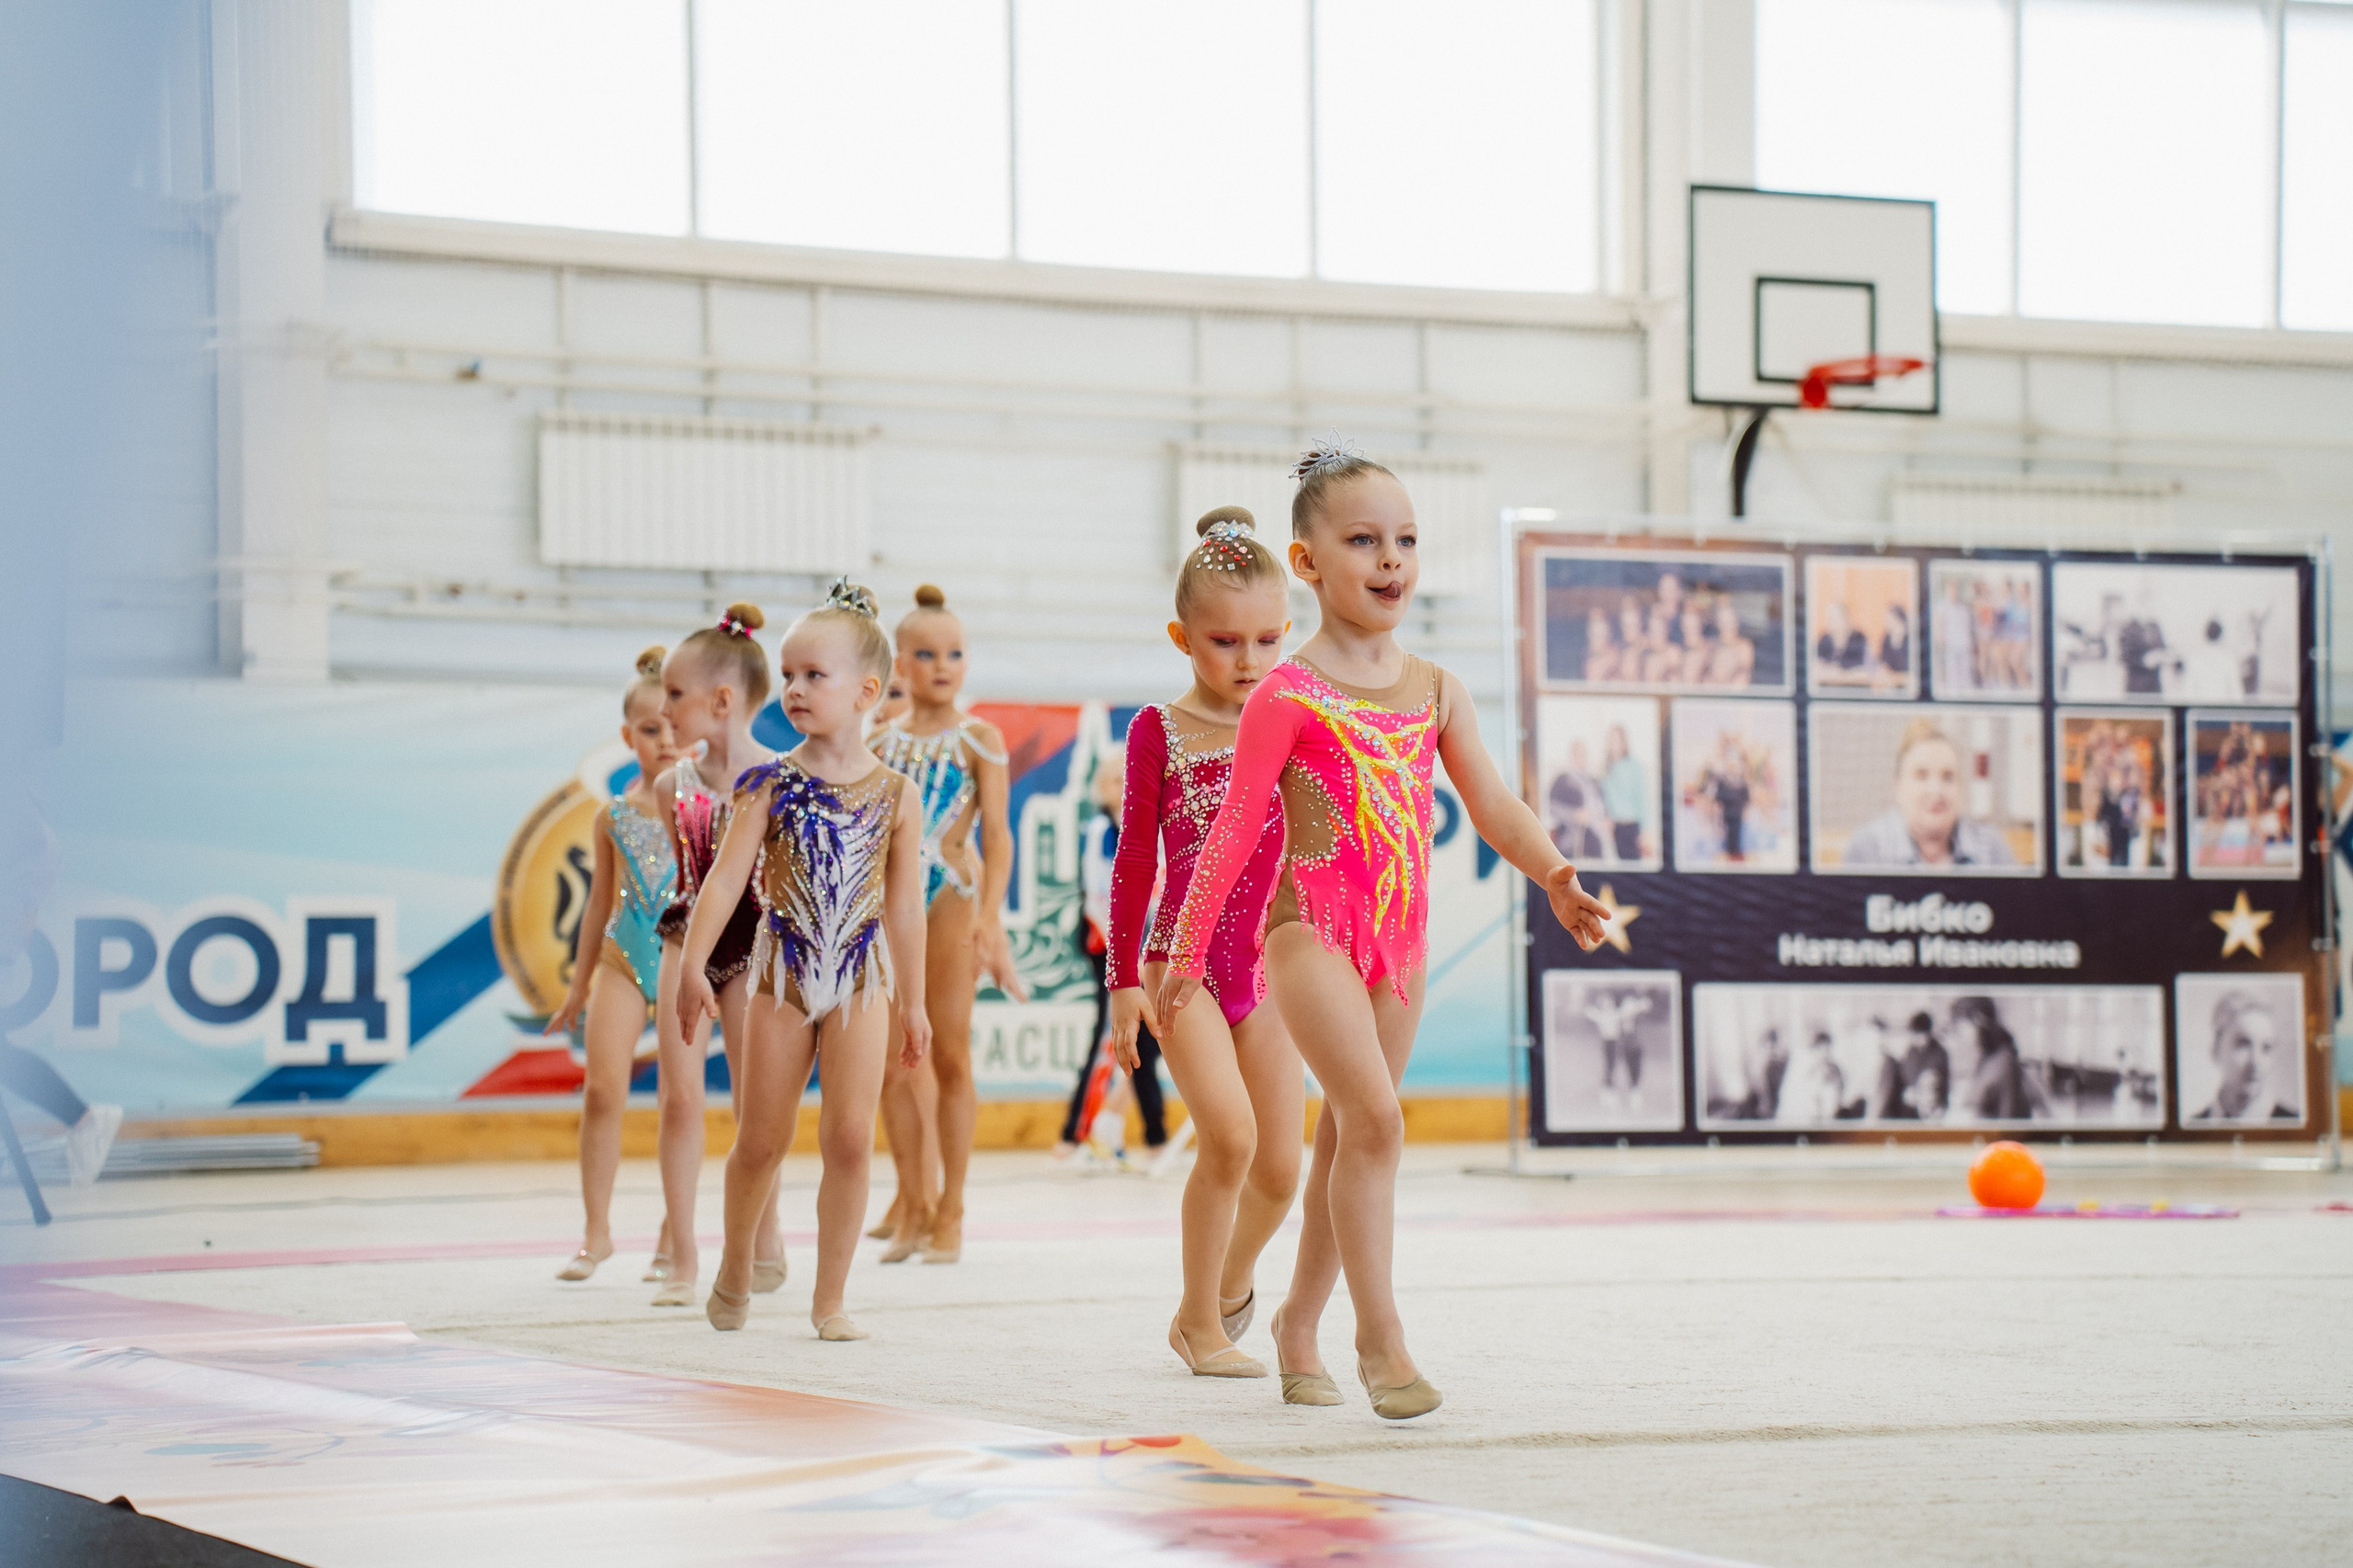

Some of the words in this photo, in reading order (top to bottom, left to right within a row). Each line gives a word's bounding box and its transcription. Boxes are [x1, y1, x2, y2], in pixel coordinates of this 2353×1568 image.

[1866, 893, 1993, 932] Бибко
[1779, 934, 1915, 967] Наталья
[1919, 935, 2080, 968] Ивановна
